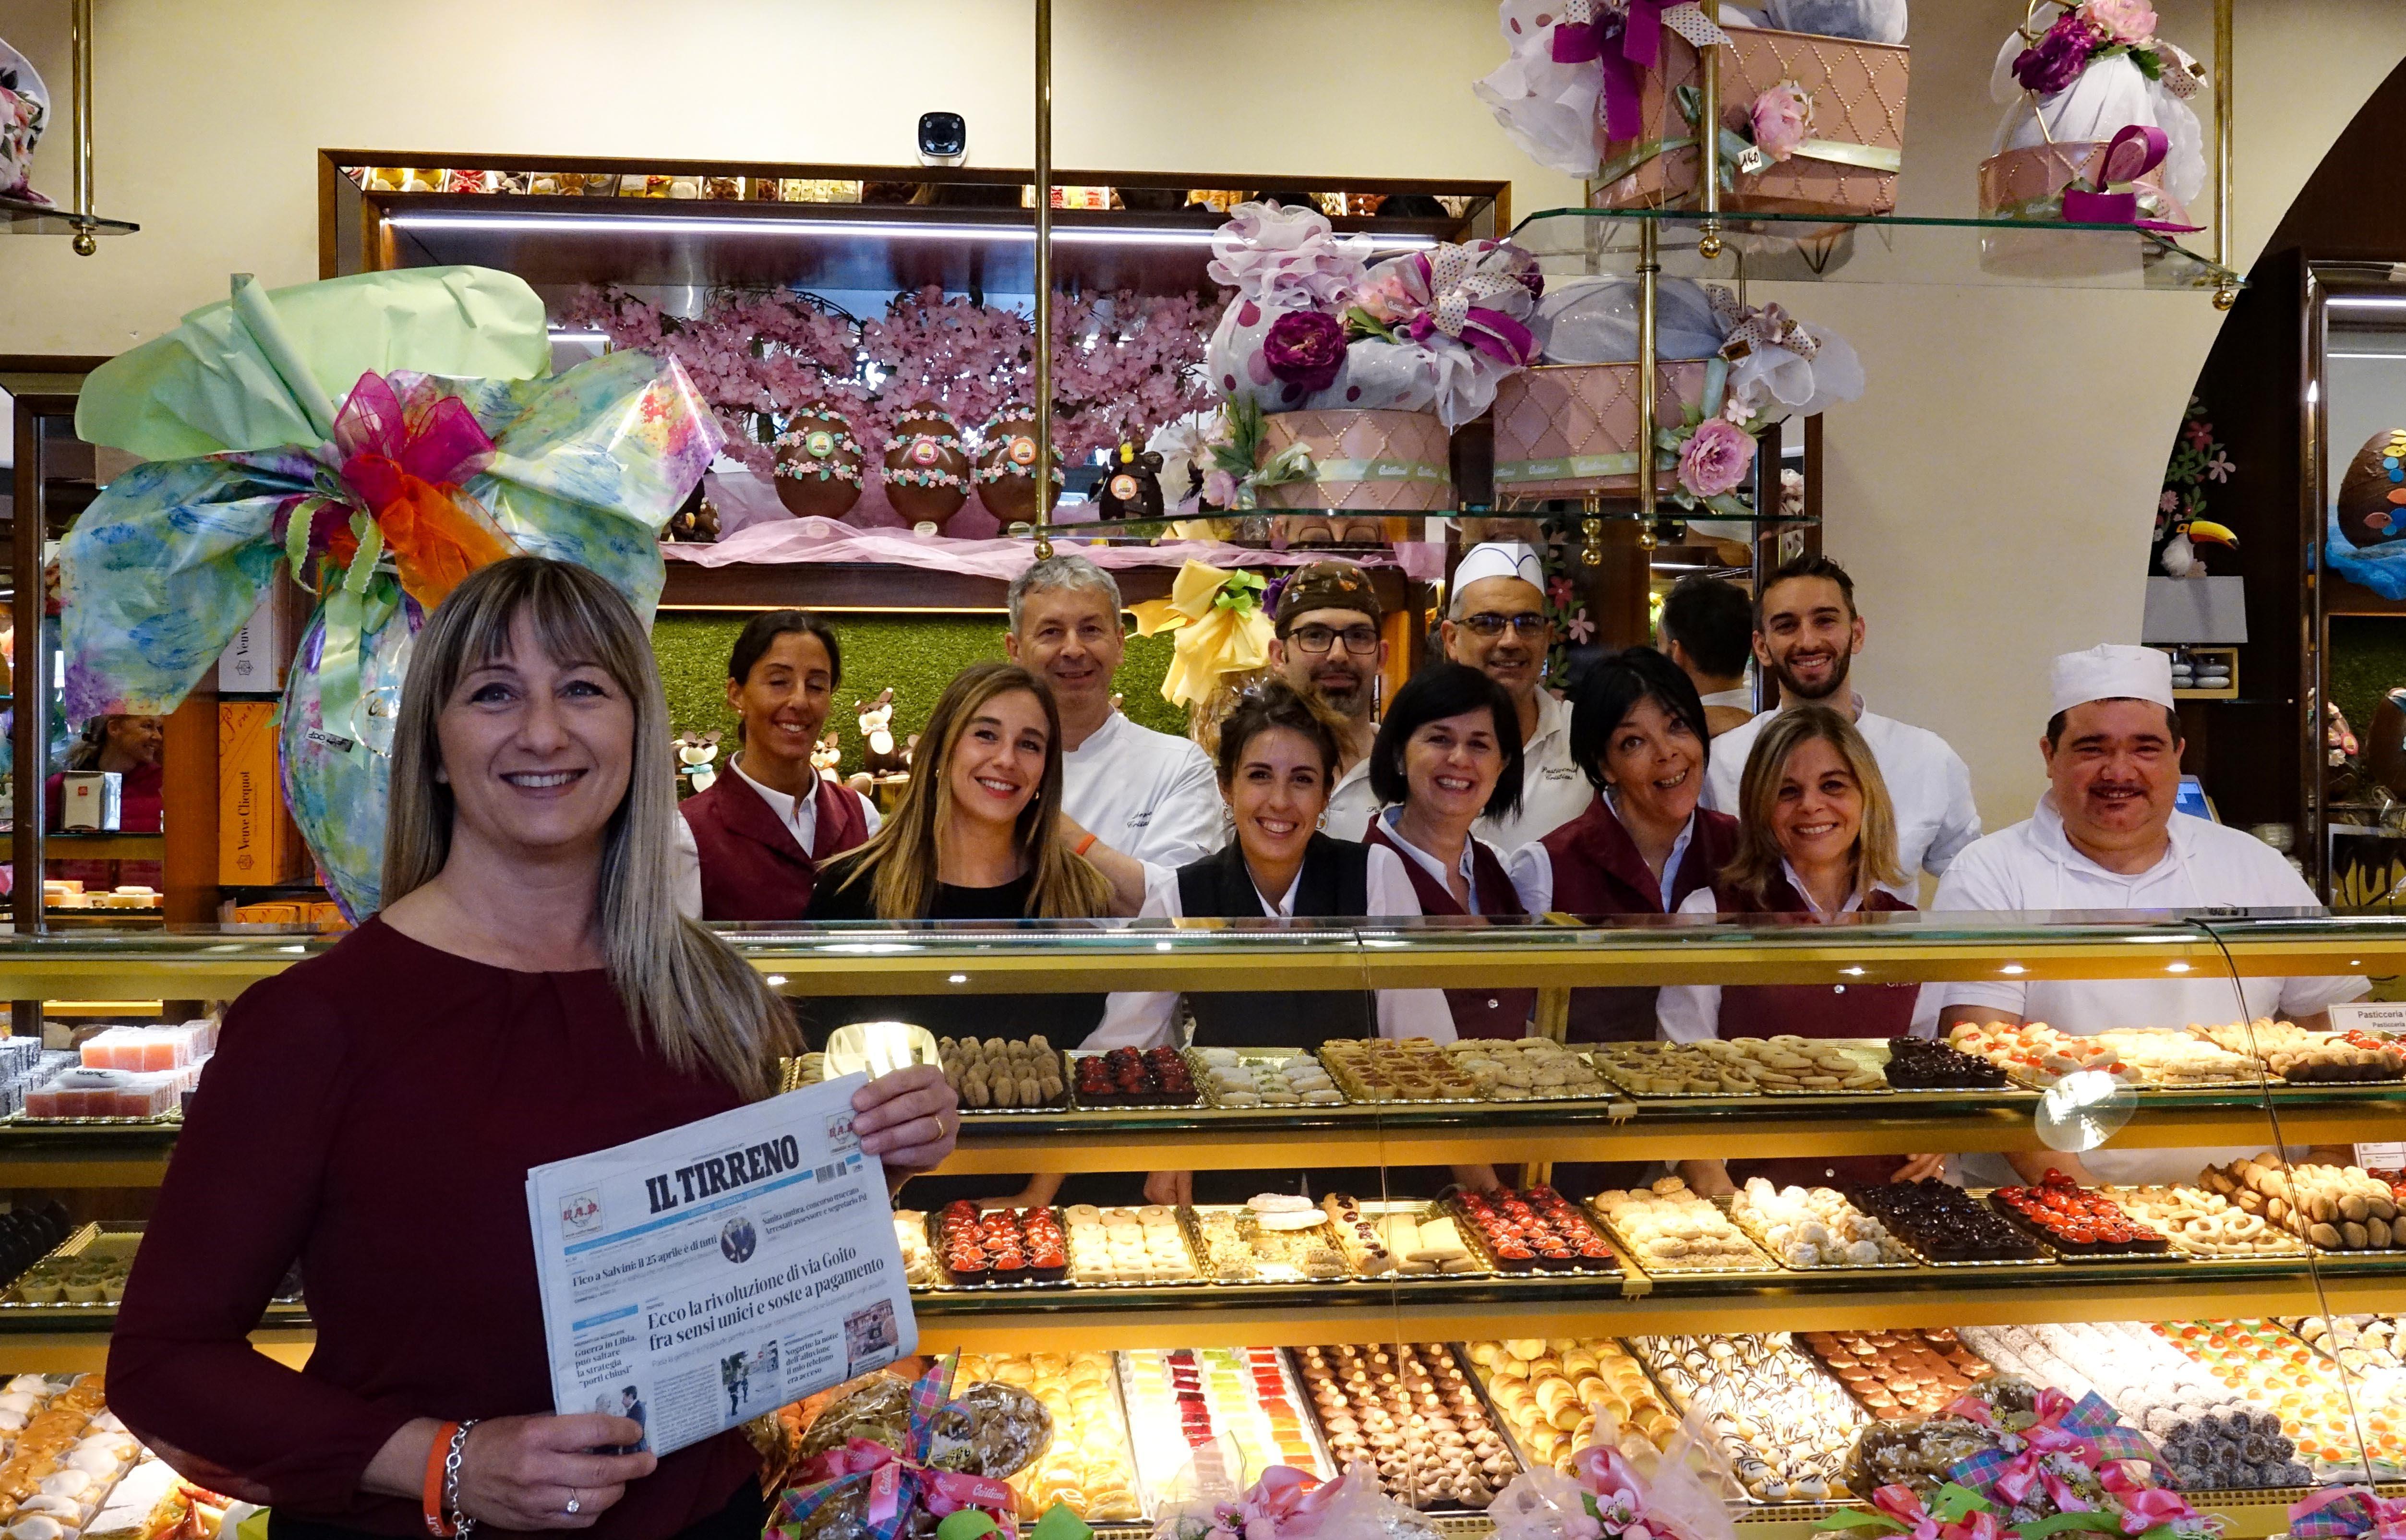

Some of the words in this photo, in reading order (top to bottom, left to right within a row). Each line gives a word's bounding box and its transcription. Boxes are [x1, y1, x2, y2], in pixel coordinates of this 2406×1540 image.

[239, 771, 253, 816] Clicquot
[238, 819, 250, 851] Veuve
[2358, 1011, 2404, 1019] Pasticceria
[645, 1173, 678, 1215] IL
[675, 1134, 799, 1203] TIRRENO
[645, 1254, 657, 1266] 25
[658, 1247, 683, 1263] aprile
[690, 1240, 699, 1251] di
[699, 1234, 718, 1249] tutti
[648, 1308, 686, 1330] Ecco
[688, 1301, 703, 1317] la
[705, 1274, 784, 1311] rivoluzione
[786, 1263, 799, 1283] di
[801, 1258, 821, 1276] via
[822, 1247, 856, 1268] Goito
[650, 1334, 673, 1351] fra
[676, 1315, 715, 1342] sensi
[718, 1302, 754, 1329] unici
[757, 1303, 765, 1315] e
[768, 1289, 802, 1311] soste
[805, 1285, 813, 1298] a
[814, 1259, 884, 1298] pagamento
